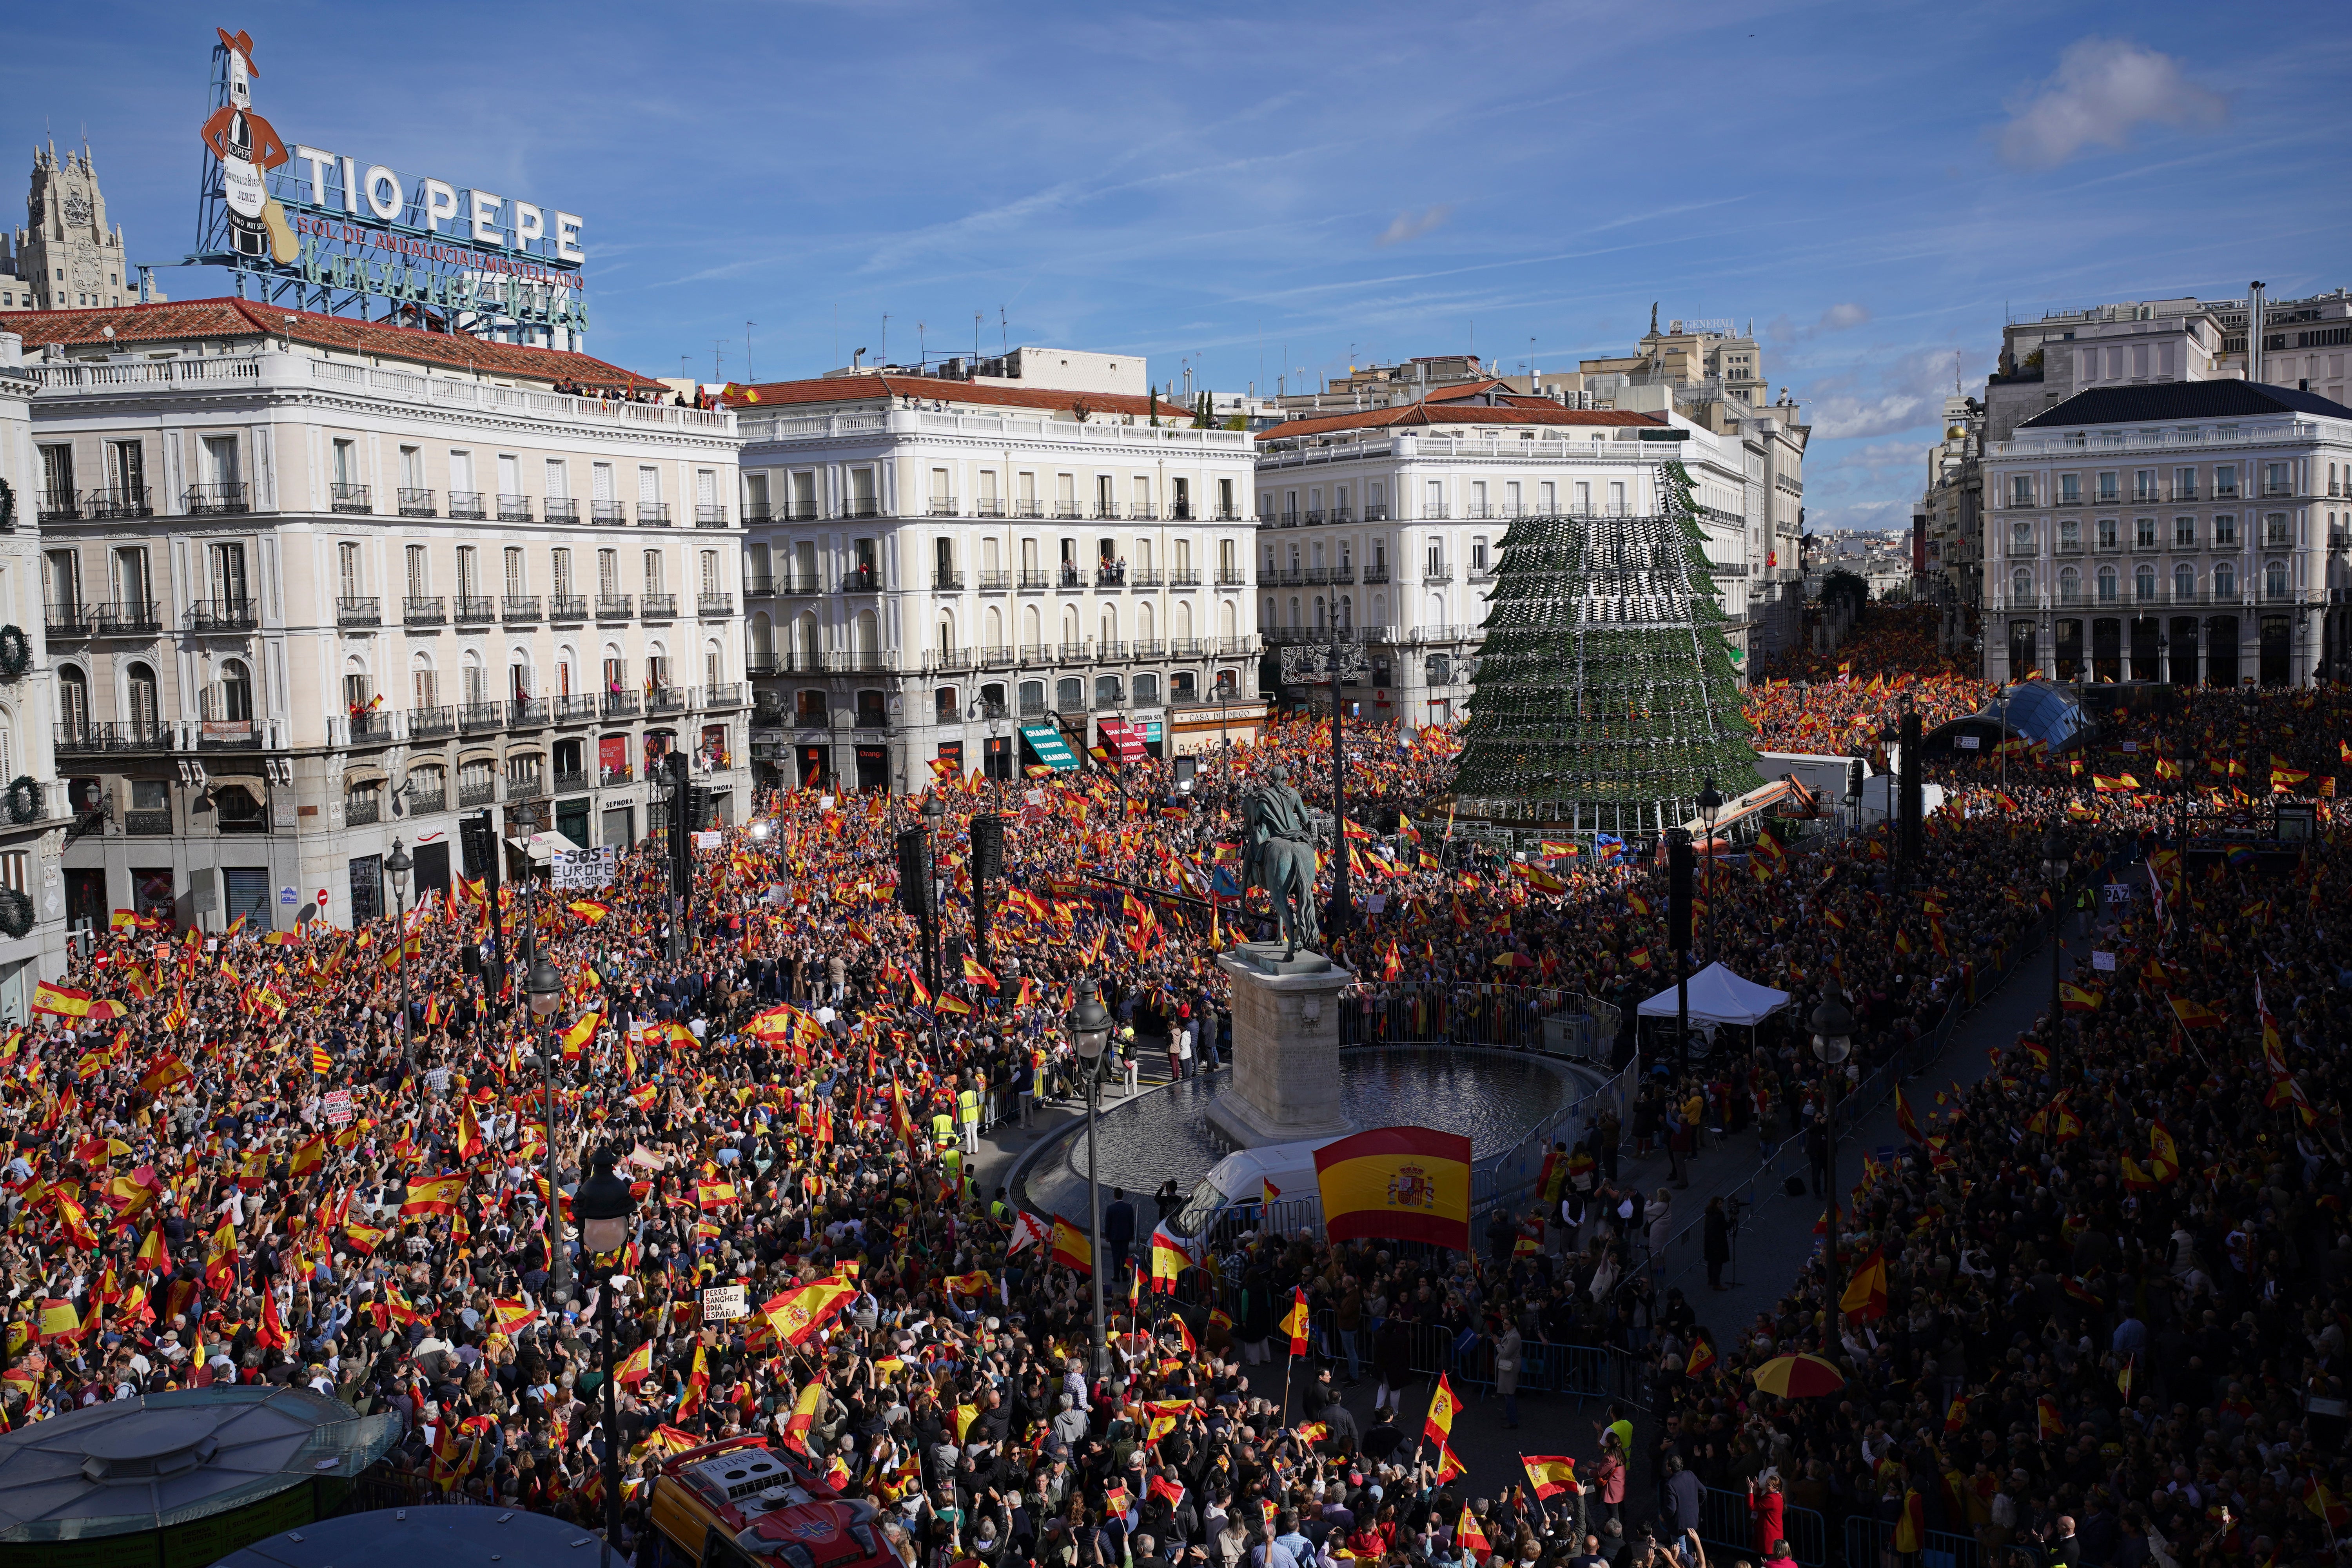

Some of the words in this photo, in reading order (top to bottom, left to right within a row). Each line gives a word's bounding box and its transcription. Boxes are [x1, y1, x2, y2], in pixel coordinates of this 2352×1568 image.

[225, 165, 247, 186] GONZALEZ
[247, 173, 261, 187] BYASS
[237, 190, 256, 203] JEREZ
[297, 143, 403, 220] TIO
[424, 176, 585, 264] PEPE
[232, 214, 244, 226] FINO
[298, 216, 338, 240] SOL
[343, 225, 367, 245] DE
[375, 233, 470, 267] ANDALUCIA
[474, 253, 584, 290] EMBOTELLADO
[304, 238, 478, 312] GONZALEZ
[506, 277, 590, 332] BYASS
[1189, 713, 1210, 722] CASA
[1227, 710, 1250, 719] DIEGO
[1026, 728, 1056, 737] CHANGE
[1042, 753, 1072, 761] CAMBIO
[606, 798, 633, 809] SEPHORA
[417, 824, 444, 837] PRIMOR
[552, 863, 613, 878] EUROPE
[2105, 889, 2129, 902] PAZ
[2093, 951, 2114, 960] SANCHEZ
[706, 1288, 727, 1297] PERRO
[706, 1294, 739, 1305] SANCHEZ
[706, 1303, 722, 1312] ODIA
[706, 1308, 737, 1319] ESPAÑA
[704, 1450, 770, 1472] SAMUR
[285, 1490, 312, 1508] RECARGAS
[232, 1510, 270, 1528] SOUVENIRS
[290, 1508, 311, 1524] TICKETS
[181, 1526, 211, 1539] PRENSA
[181, 1531, 217, 1545] REVISTAS
[233, 1532, 252, 1543] AGUA
[252, 1531, 272, 1542] DRINK
[116, 1543, 153, 1554] RECARGAS
[188, 1547, 213, 1559] TOURS
[56, 1551, 96, 1561] SOUVENIRS
